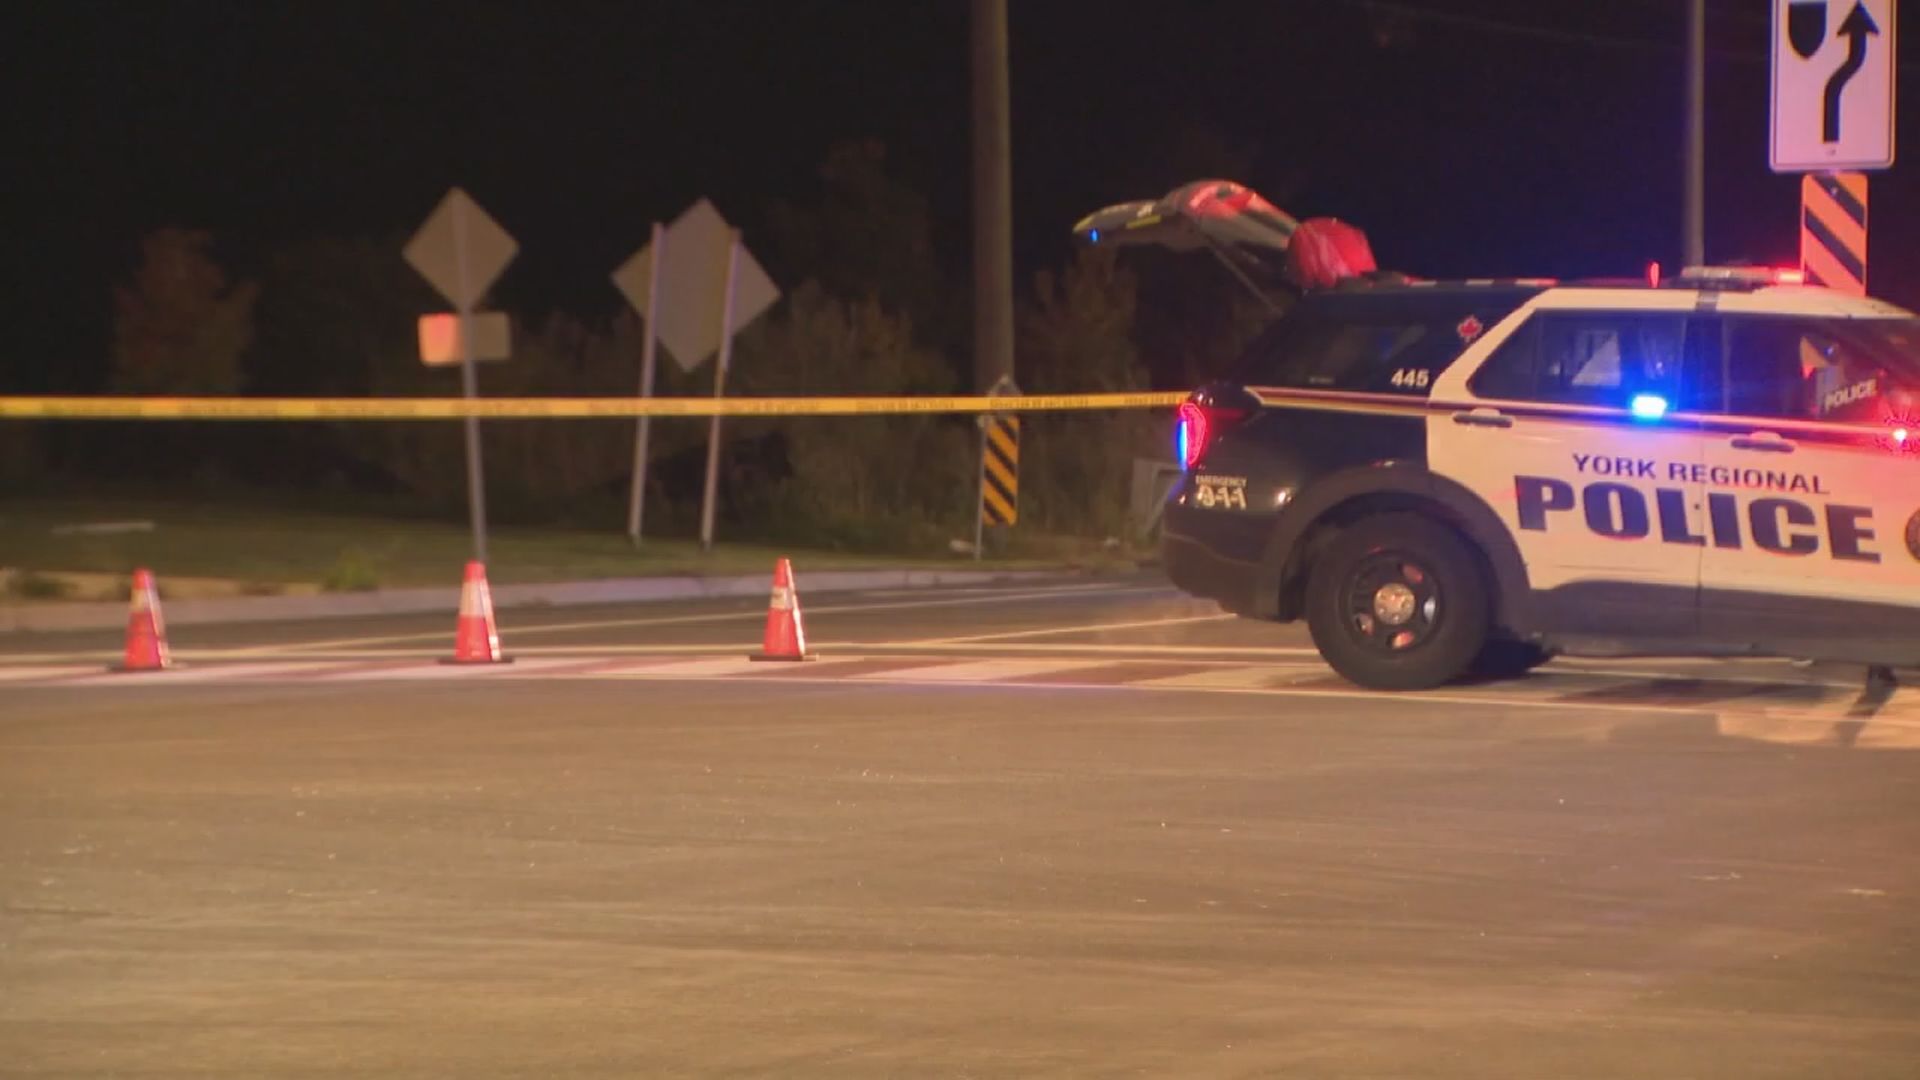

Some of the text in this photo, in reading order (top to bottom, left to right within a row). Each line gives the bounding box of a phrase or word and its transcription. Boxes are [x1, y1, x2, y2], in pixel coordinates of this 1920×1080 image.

[1391, 368, 1429, 386] 445
[1825, 379, 1877, 411] POLICE
[1195, 475, 1248, 487] EMERGENCY
[1573, 453, 1830, 495] YORK REGIONAL
[1514, 475, 1881, 563] POLICE
